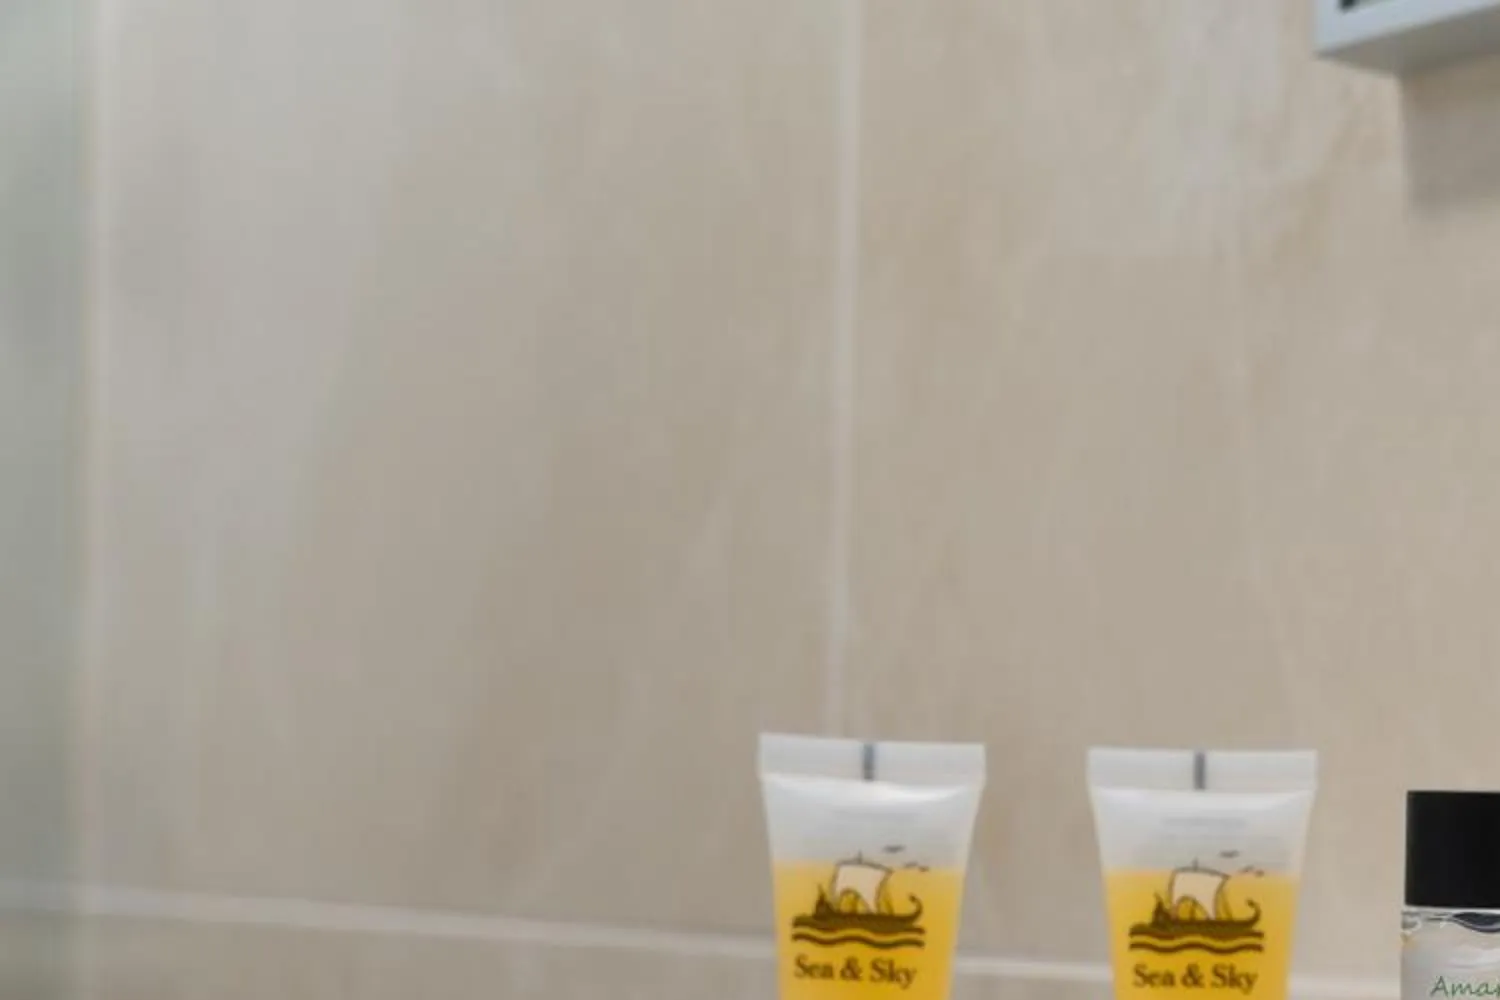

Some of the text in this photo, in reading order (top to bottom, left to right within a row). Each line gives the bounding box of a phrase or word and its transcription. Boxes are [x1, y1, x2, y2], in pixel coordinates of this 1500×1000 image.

[794, 953, 917, 990] Sea & Sky
[1132, 963, 1258, 994] Sea & Sky
